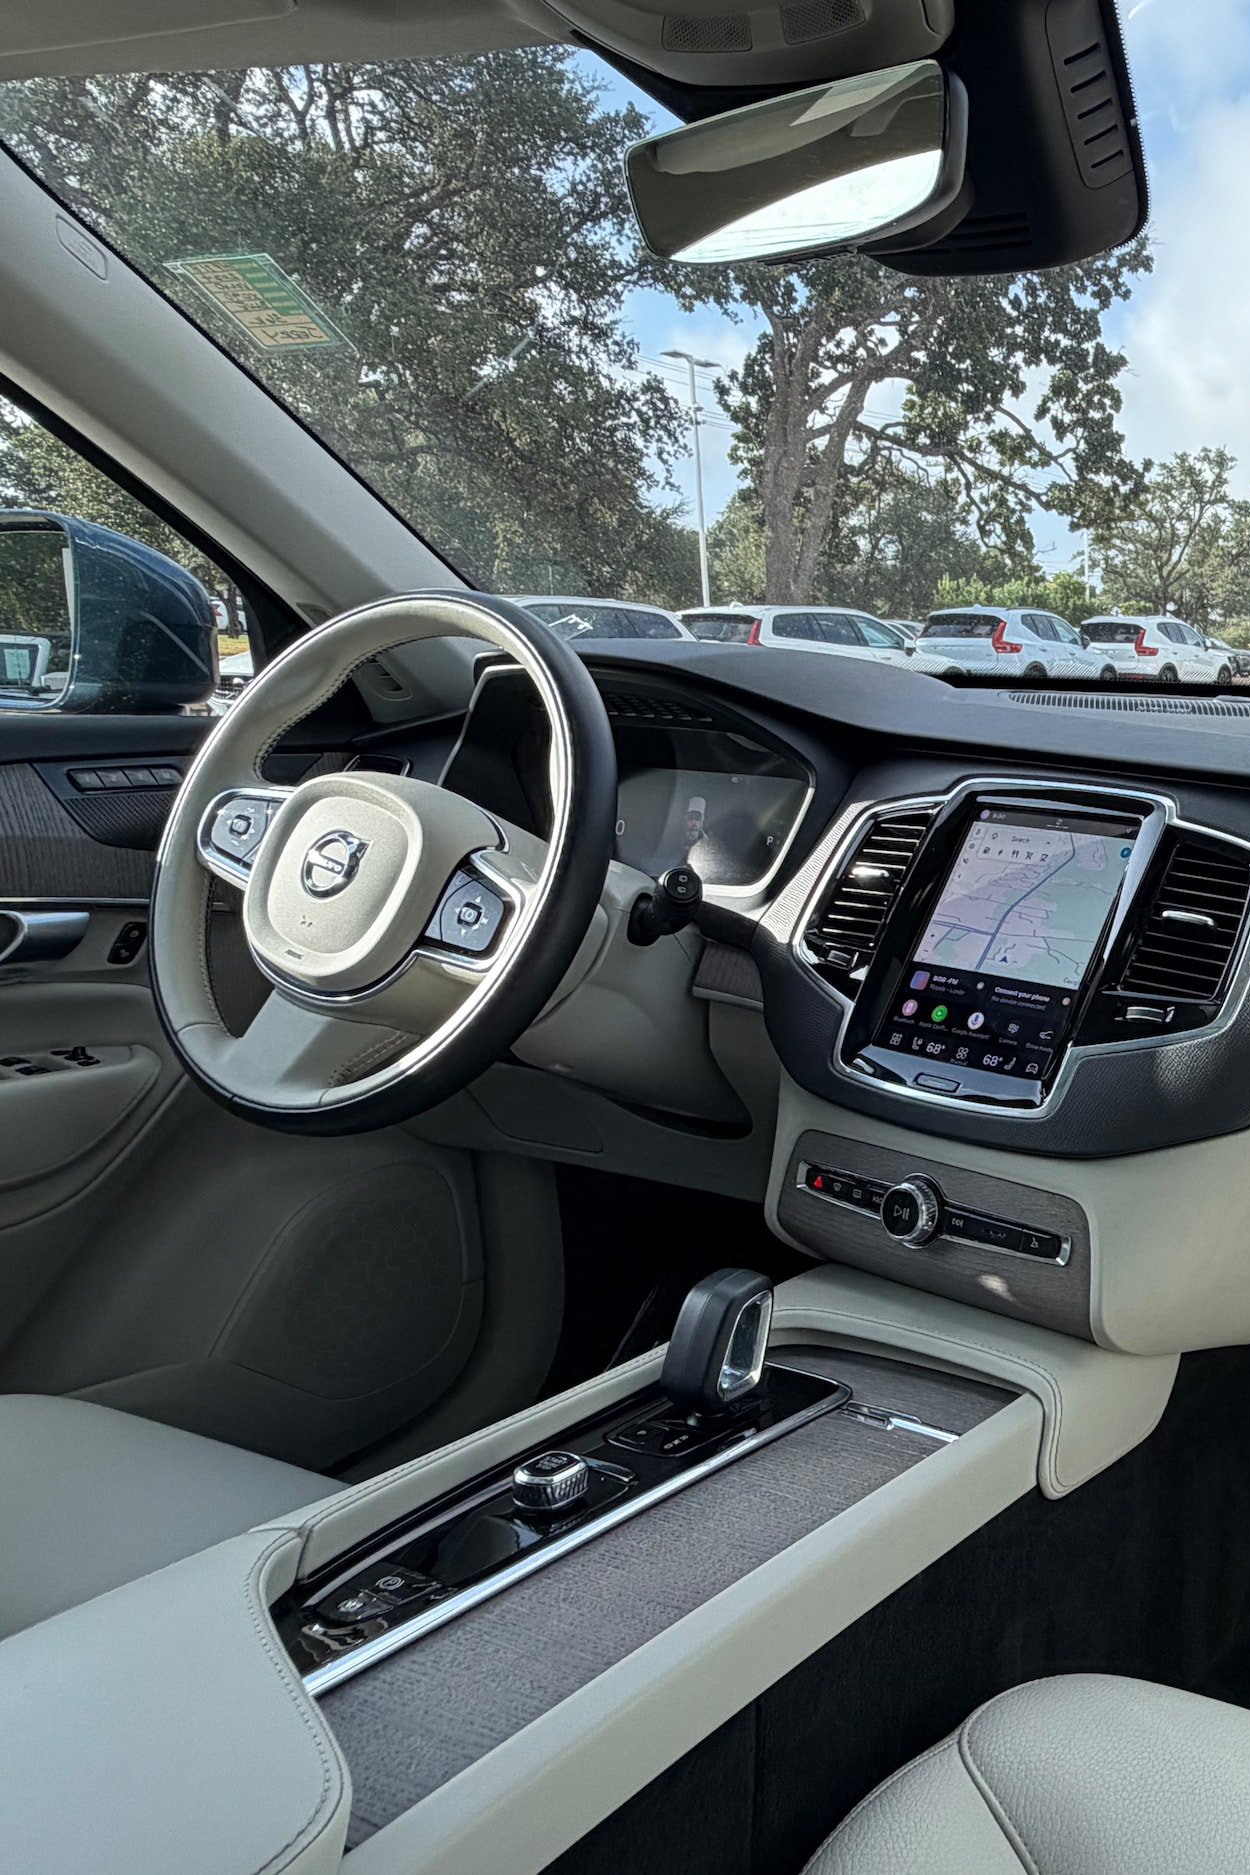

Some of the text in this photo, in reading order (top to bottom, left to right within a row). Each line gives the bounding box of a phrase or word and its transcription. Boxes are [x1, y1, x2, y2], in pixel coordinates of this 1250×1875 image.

[766, 834, 774, 847] P
[1011, 835, 1031, 844] Search
[994, 986, 1051, 1002] Connect your phone
[926, 1042, 946, 1055] 68°
[982, 1054, 1004, 1067] 68°
